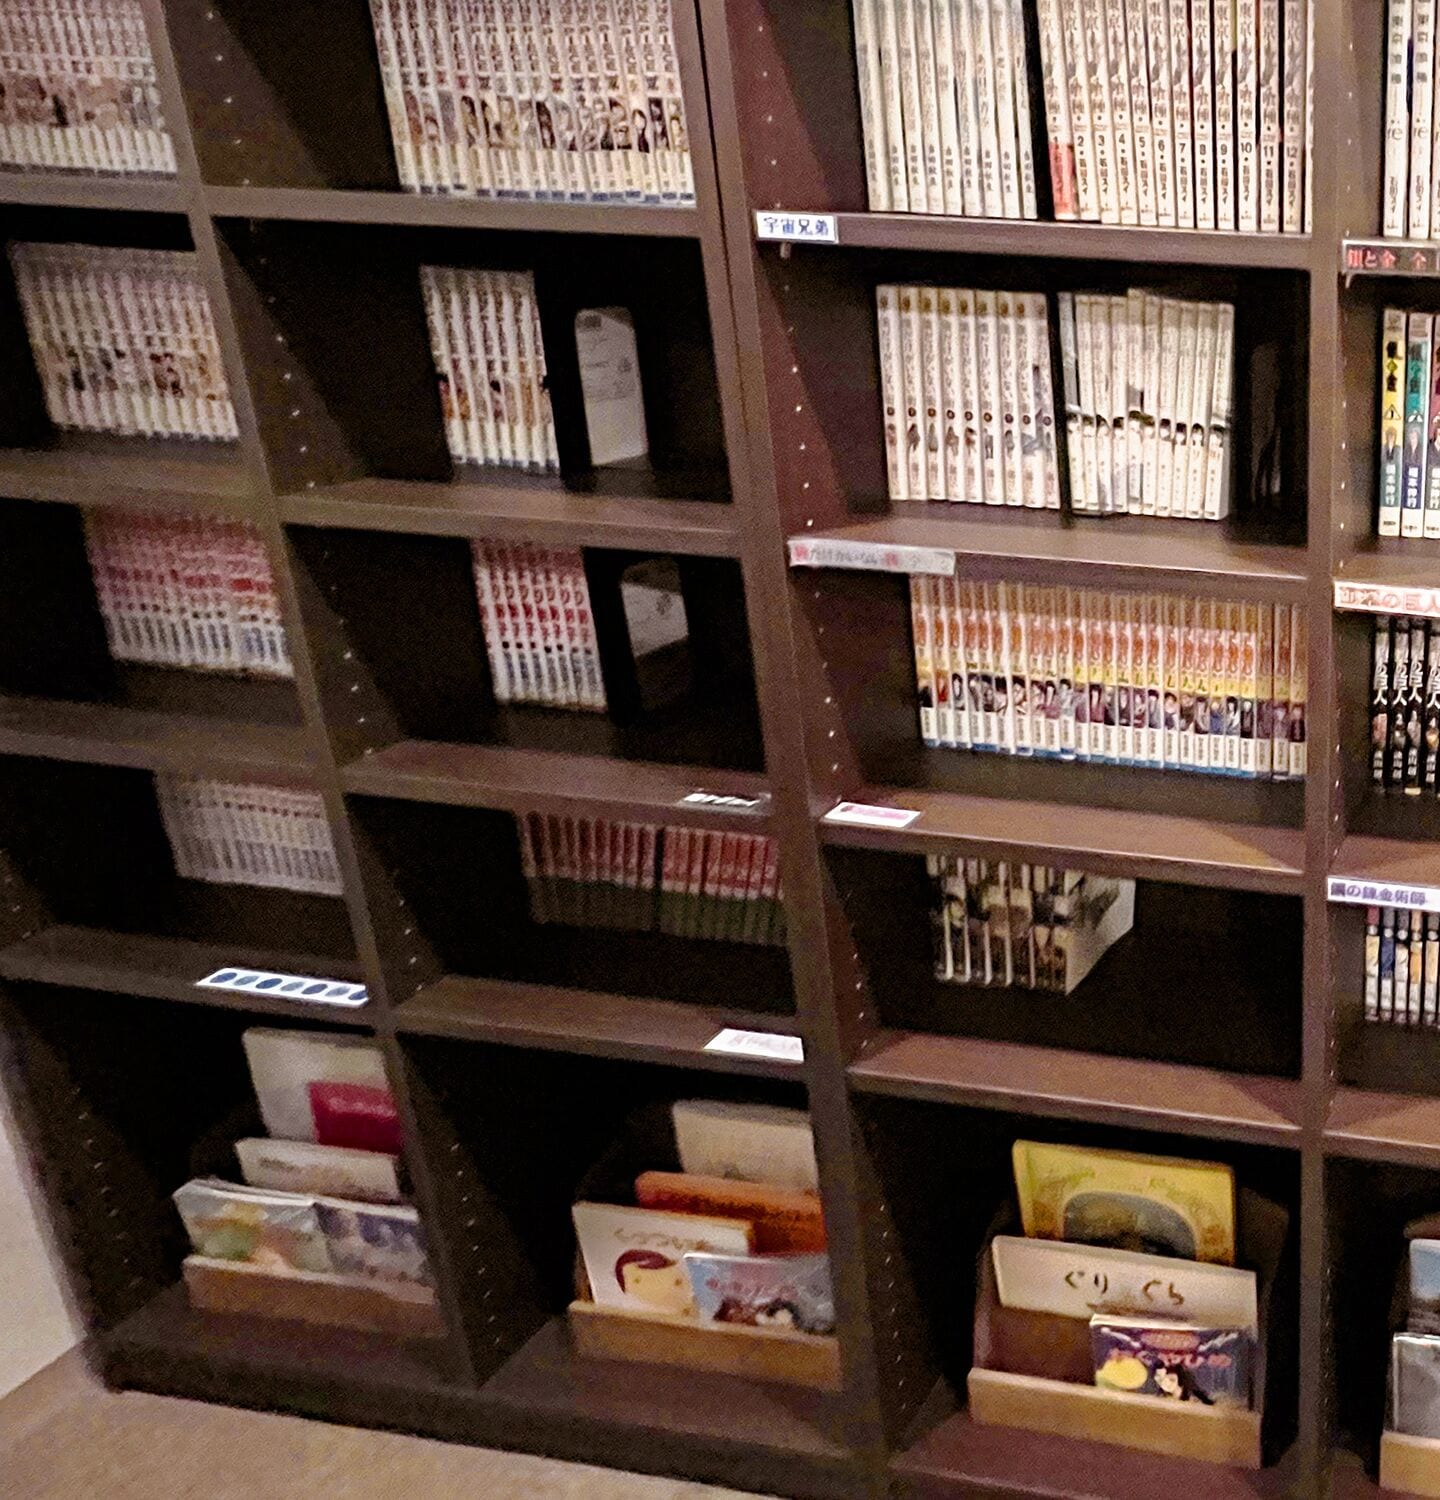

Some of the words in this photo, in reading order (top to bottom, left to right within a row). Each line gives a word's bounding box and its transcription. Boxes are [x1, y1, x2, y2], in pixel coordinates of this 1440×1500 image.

[1078, 137, 1084, 146] 2
[1099, 136, 1105, 146] 3
[1119, 134, 1125, 144] 4
[1139, 137, 1145, 148] 5
[1158, 140, 1164, 151] 6
[1180, 144, 1186, 153] 7
[1200, 145, 1206, 155] 8
[1221, 145, 1227, 155] 9
[1241, 143, 1252, 153] 10
[1264, 146, 1274, 157] 11
[1286, 146, 1298, 157] 12
[764, 217, 828, 235] 宇宙兄弟
